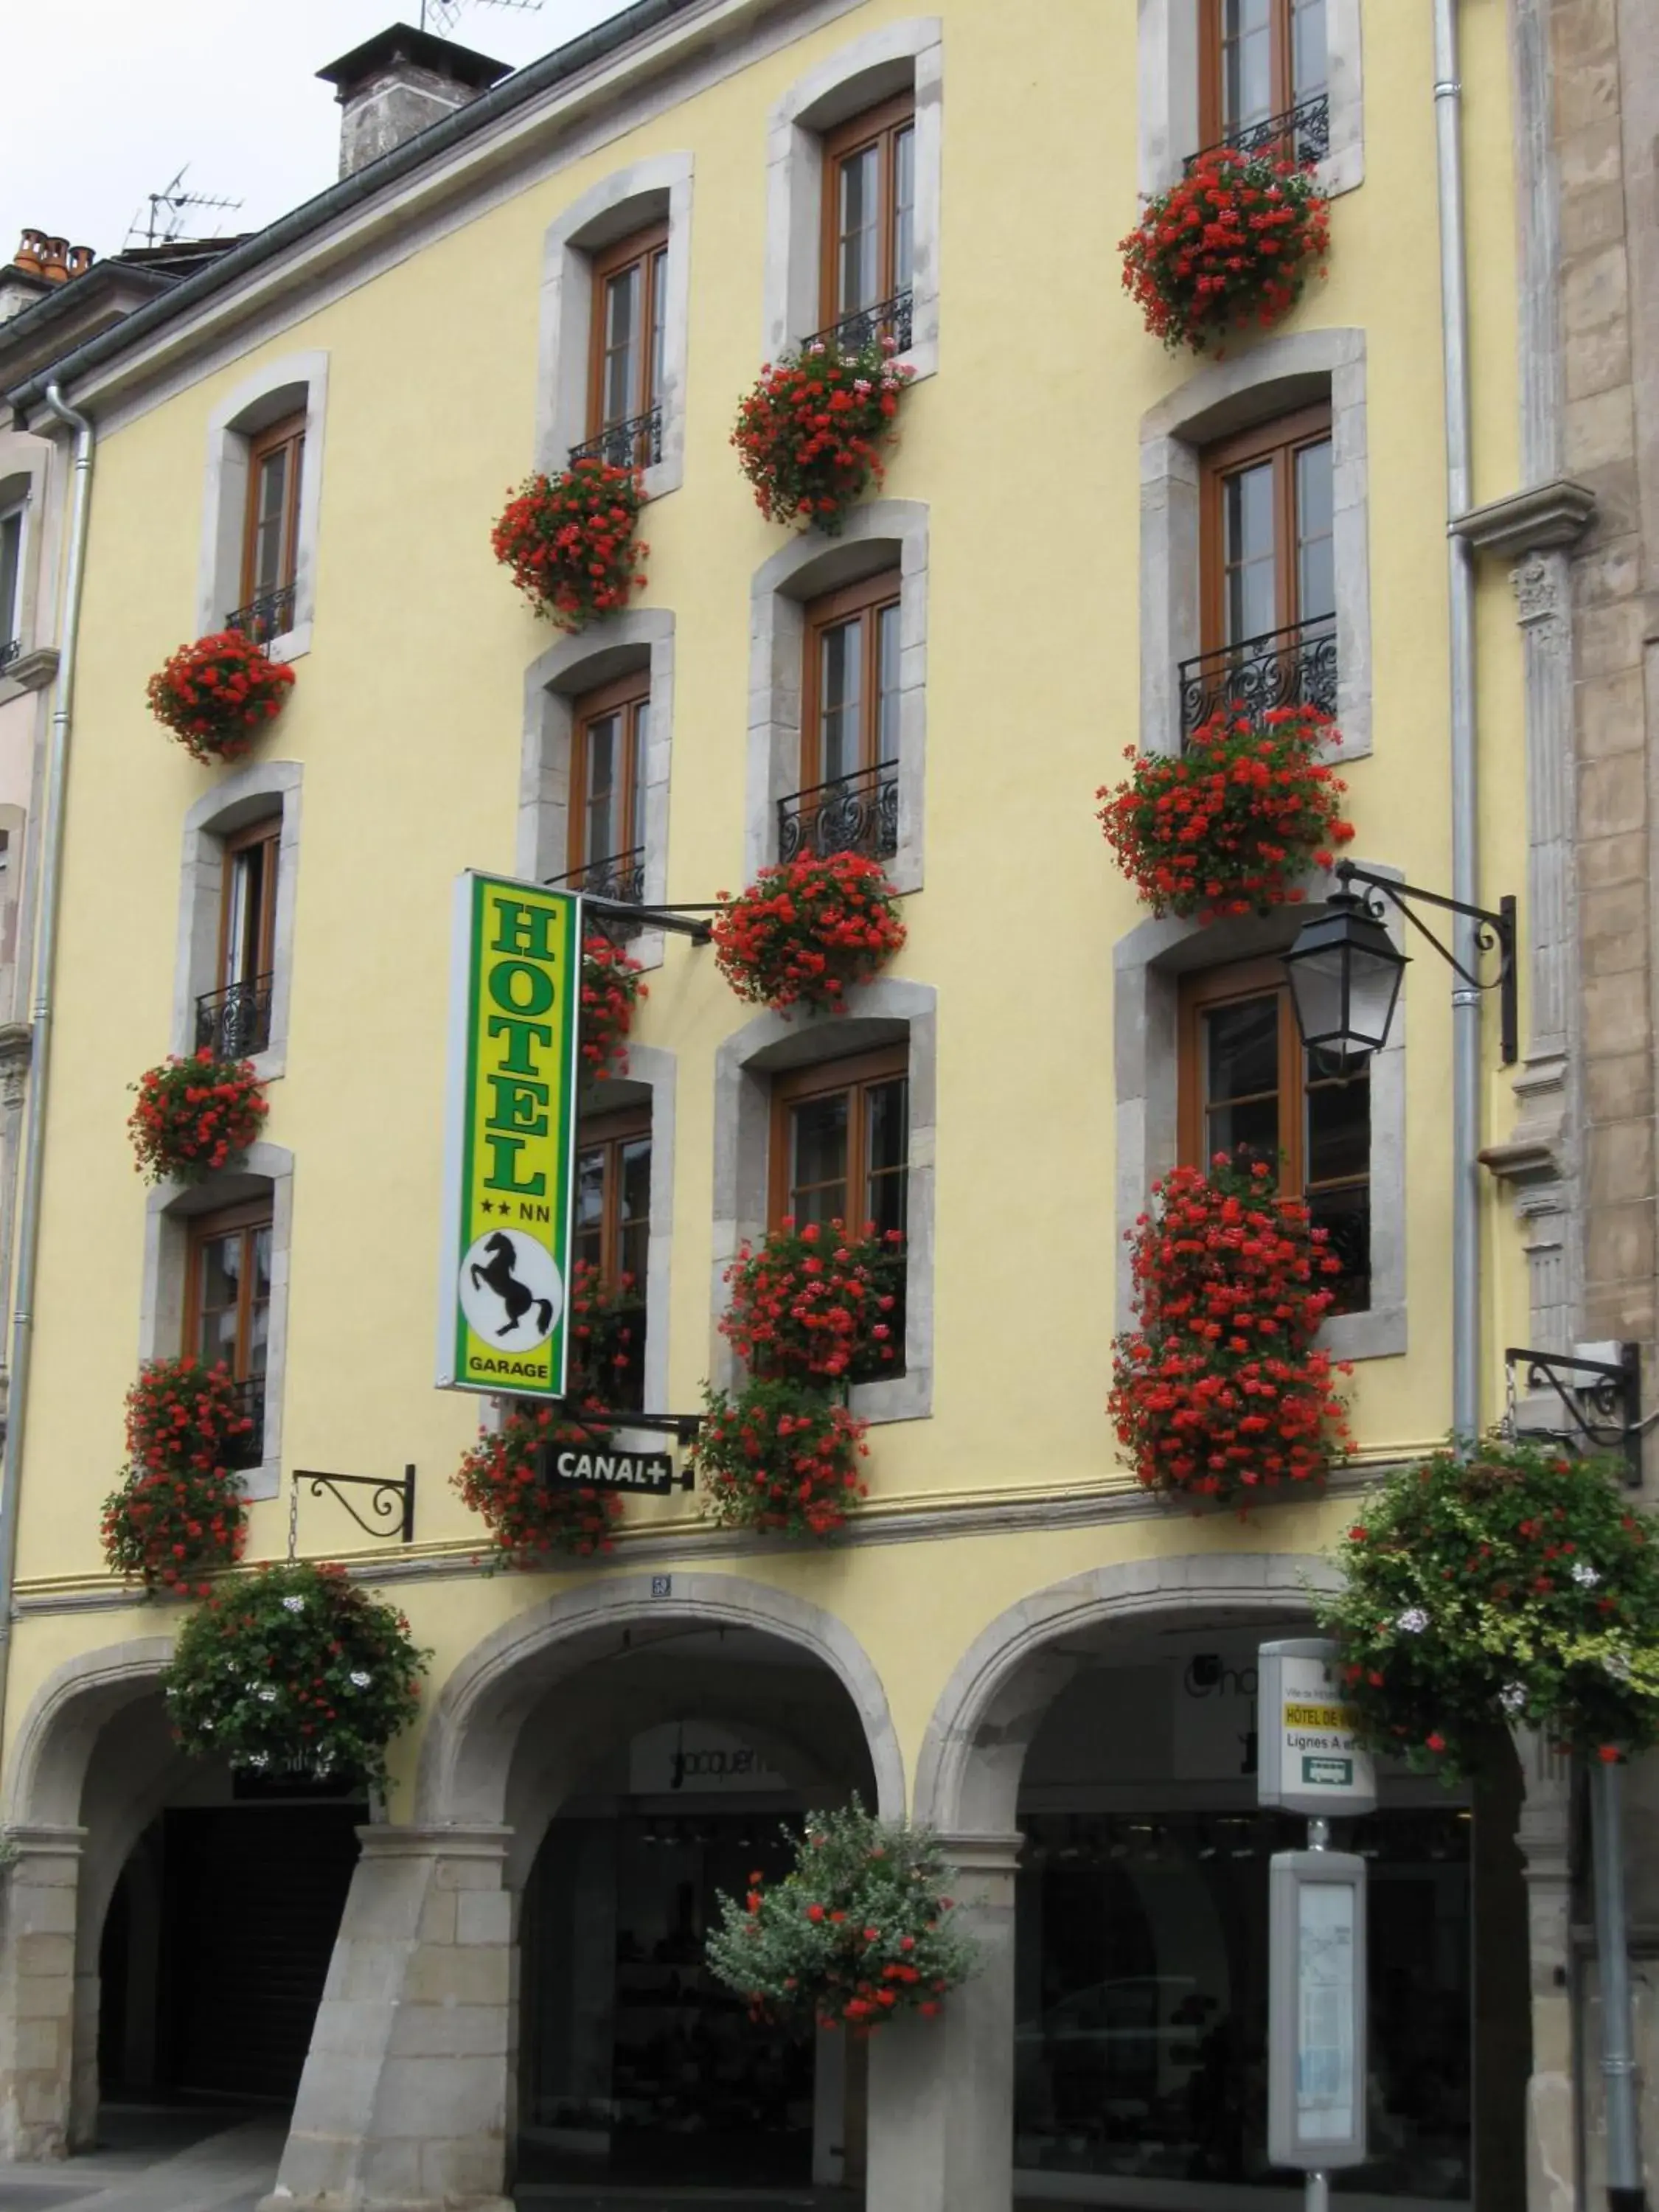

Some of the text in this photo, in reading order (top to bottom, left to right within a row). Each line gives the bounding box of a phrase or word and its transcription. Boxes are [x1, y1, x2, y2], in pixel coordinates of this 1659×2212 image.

[484, 897, 557, 1197] HOTEL
[519, 1202, 550, 1223] NN
[469, 1356, 549, 1380] GARAGE
[556, 1451, 667, 1485] CANAL+
[1287, 1705, 1321, 1726] HÔTEL
[1324, 1710, 1338, 1727] DE
[1287, 1733, 1328, 1751] Lignes
[1331, 1736, 1340, 1750] A
